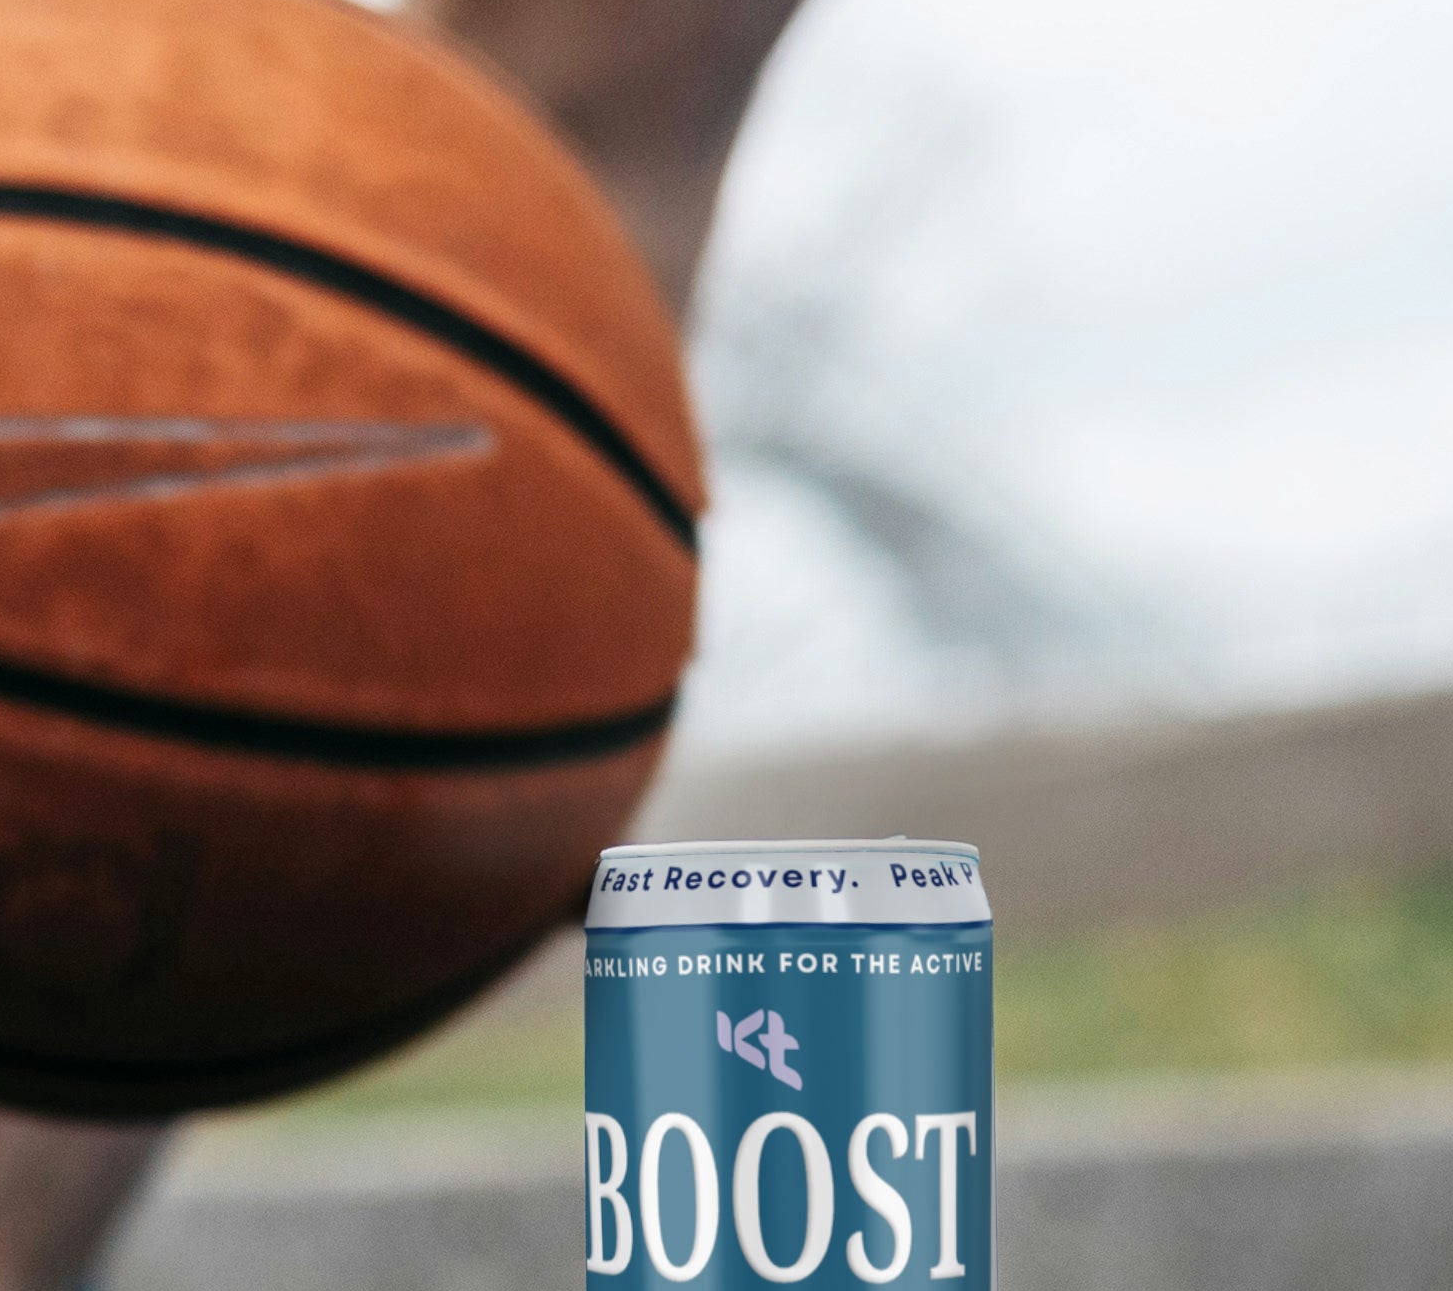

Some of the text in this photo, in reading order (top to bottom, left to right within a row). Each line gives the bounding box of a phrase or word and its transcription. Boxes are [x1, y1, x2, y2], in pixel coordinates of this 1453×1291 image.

[600, 868, 654, 892] Fast
[663, 866, 859, 894] Recovery.
[889, 861, 960, 888] Peak
[678, 953, 765, 975] DRINK
[779, 953, 838, 974] FOR
[850, 953, 901, 974] THE
[910, 951, 983, 974] ACTIVE
[585, 1111, 977, 1285] BOOST
